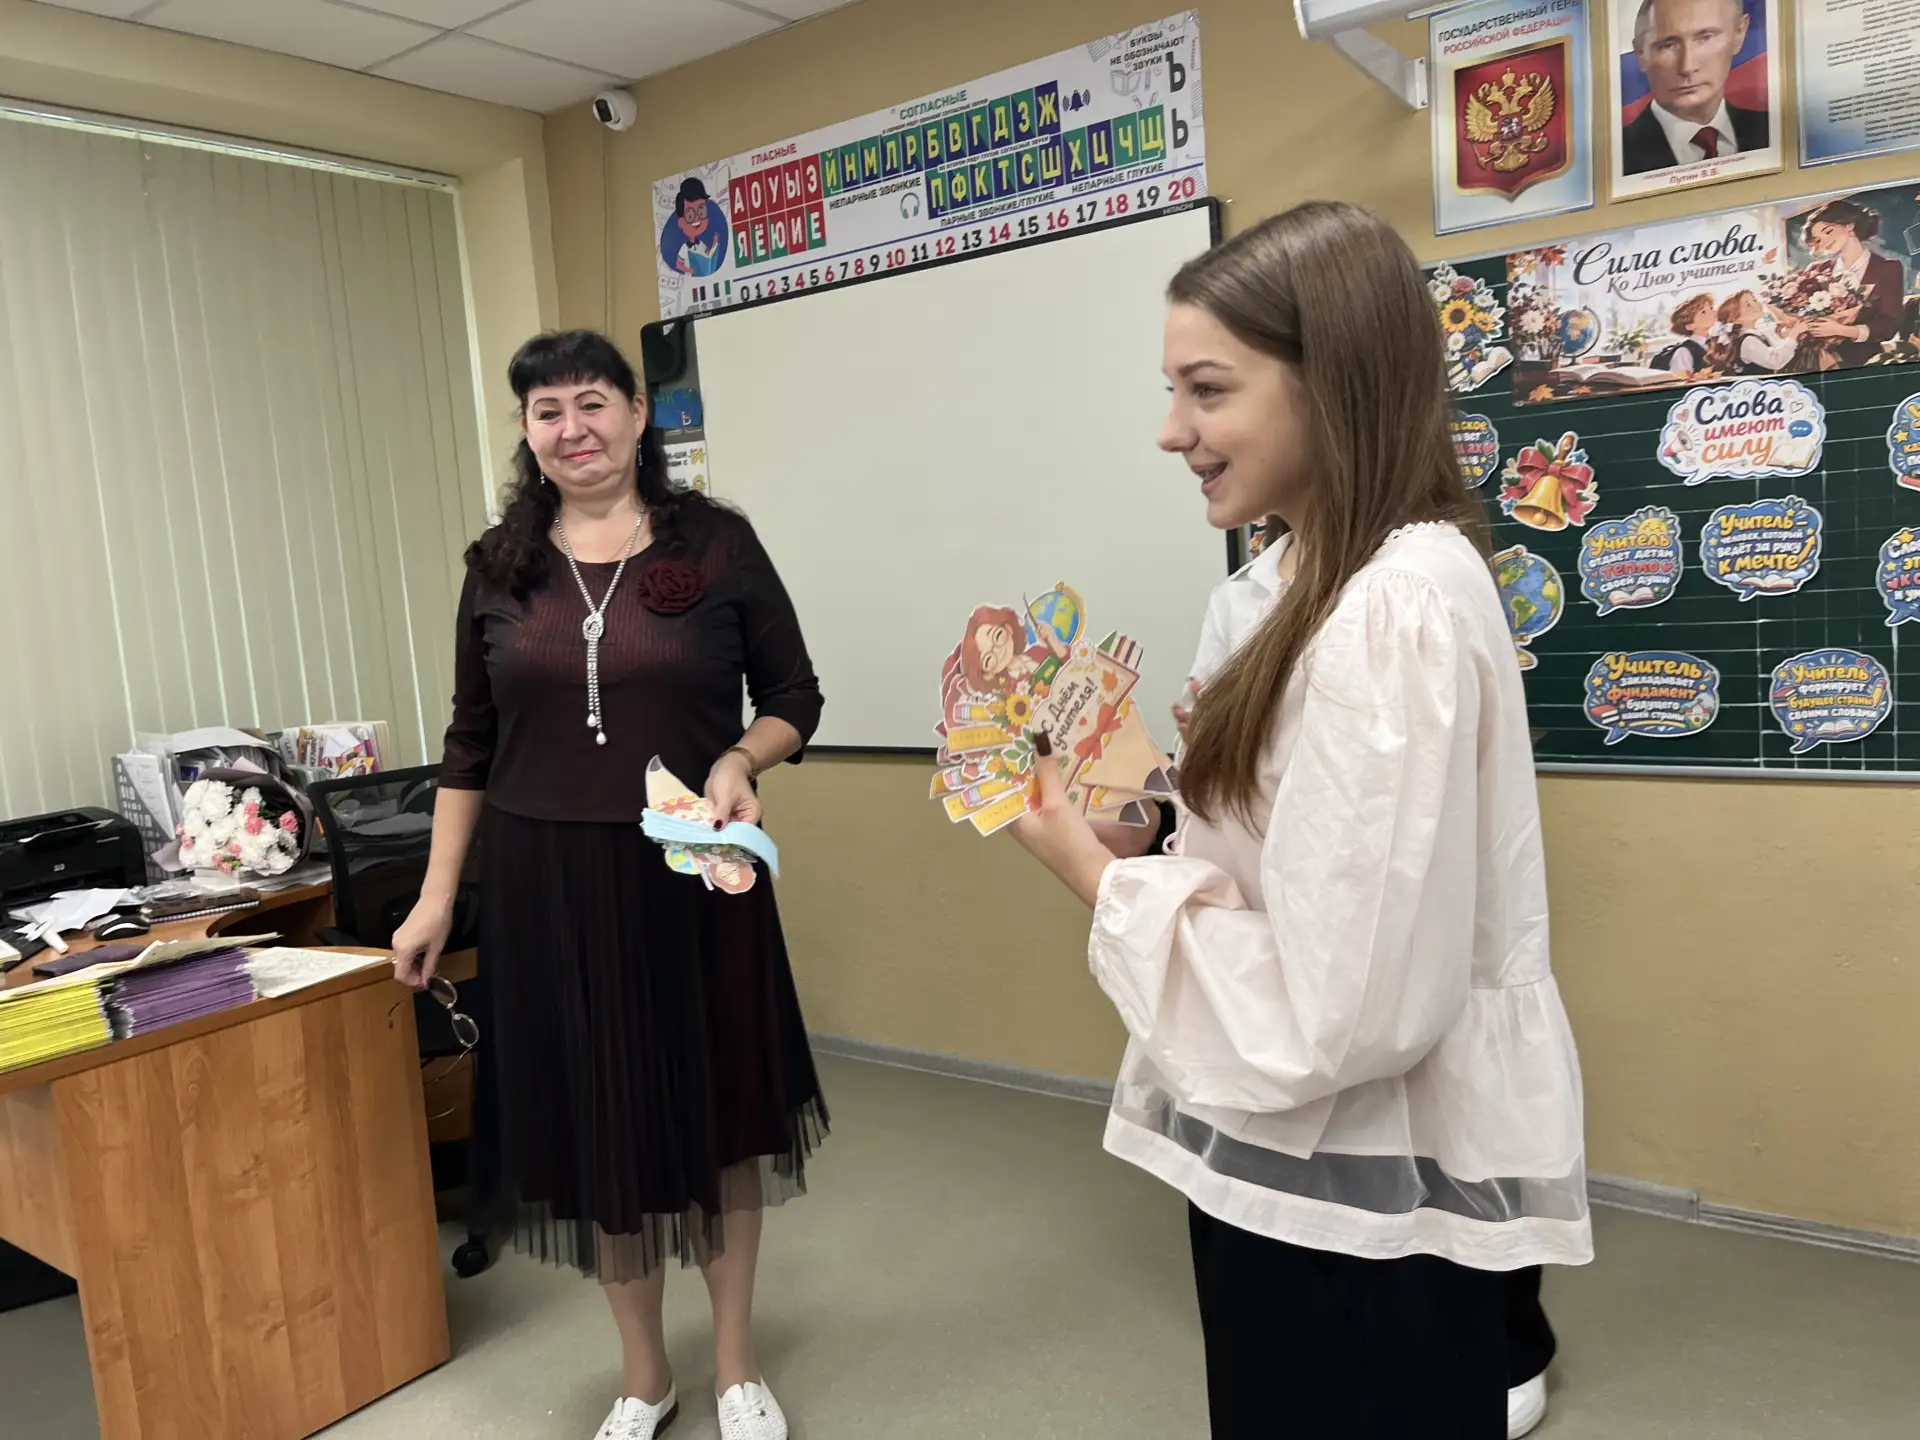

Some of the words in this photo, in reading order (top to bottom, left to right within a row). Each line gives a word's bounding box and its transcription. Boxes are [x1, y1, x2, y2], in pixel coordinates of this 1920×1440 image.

[1438, 3, 1548, 42] ГОСУДАРСТВЕННЫЙ
[1110, 56, 1122, 66] НЕ
[1124, 36, 1184, 61] ОБОЗНАЧАЮТ
[1130, 31, 1162, 48] БУКВЫ
[1444, 30, 1510, 55] РОССИЙСКОЙ
[1132, 55, 1162, 71] ЗВУКИ
[1166, 51, 1186, 93] Ъ
[900, 90, 967, 120] СОГЛАСНЫЕ
[752, 143, 797, 166] ГЛАСНЫЕ
[1072, 172, 1124, 193] НЕПАРНЫЕ
[1126, 162, 1164, 180] ГЛУХИЕ
[829, 189, 878, 210] НЕПАРНЫЕ
[880, 177, 921, 196] ЗВОНКИЕ
[941, 211, 976, 226] ПАРНЫЕ
[740, 286, 750, 301] 0
[755, 283, 762, 299] 1
[767, 279, 776, 296] 2
[781, 276, 790, 292] 3
[795, 272, 805, 288] 4
[810, 269, 820, 285] 5
[825, 266, 834, 282] 6
[840, 262, 848, 279] 7
[854, 258, 864, 275] 8
[870, 254, 880, 272] 9
[886, 248, 905, 268] 10
[911, 243, 929, 262] 11
[936, 236, 956, 256] 12
[962, 229, 982, 250] 13
[989, 222, 1011, 244] 14
[1018, 215, 1040, 237] 15
[1047, 208, 1069, 230] 16
[1076, 201, 1097, 224] 17
[1105, 193, 1128, 216] 18
[1136, 185, 1160, 209] 19
[1168, 176, 1195, 202] 20
[1573, 242, 1663, 286] Сила
[1670, 224, 1764, 265] слова.
[1606, 276, 1629, 294] Ко
[1632, 272, 1675, 292] Дню
[1677, 259, 1755, 287] учителя
[1695, 390, 1784, 425] Слова
[1704, 417, 1785, 441] имеют
[1702, 436, 1773, 466] силу
[1719, 514, 1794, 536] Учитель
[1762, 529, 1804, 540] который
[1588, 534, 1671, 557] Учитель
[1634, 550, 1674, 559] детям
[1754, 543, 1770, 552] за
[1772, 542, 1801, 554] руку
[1734, 554, 1799, 571] мечте
[1605, 654, 1702, 680] Учитель
[1791, 664, 1869, 684] Учитель
[1620, 677, 1695, 687] закладывает
[1798, 682, 1866, 695] формирует
[1048, 682, 1079, 722] Днём
[1607, 684, 1697, 704] фундамент
[1626, 699, 1680, 711] будущего
[1789, 696, 1834, 708] будущее
[1837, 696, 1873, 706] страны
[1053, 676, 1098, 751] учителя!
[1650, 711, 1686, 721] страны
[1788, 709, 1829, 720] своими
[1831, 708, 1878, 718] словами
